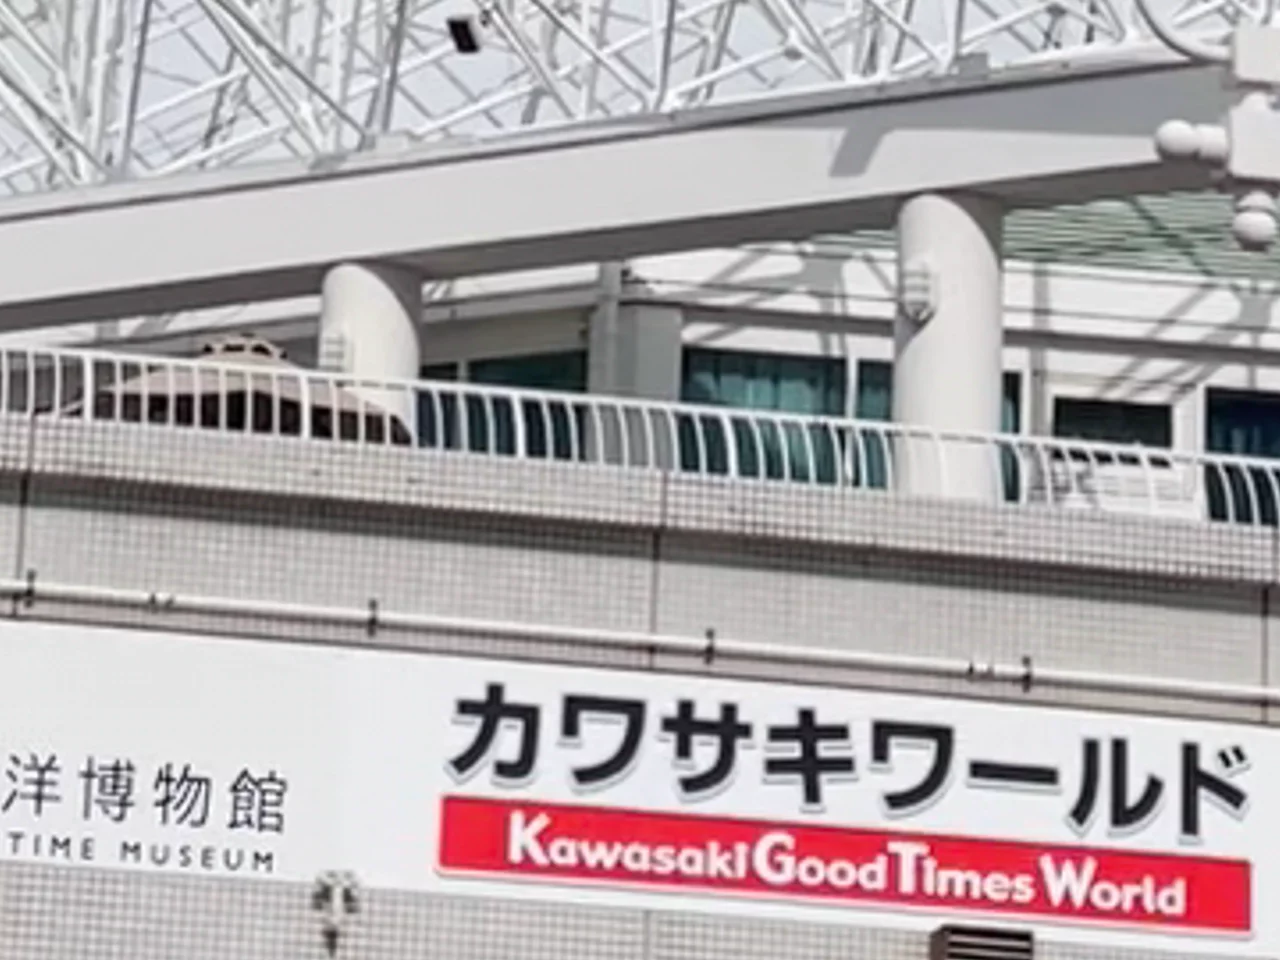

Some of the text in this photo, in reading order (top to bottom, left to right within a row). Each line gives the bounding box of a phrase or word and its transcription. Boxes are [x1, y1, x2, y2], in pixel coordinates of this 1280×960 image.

[451, 683, 1245, 836] カワサキワールド
[121, 842, 276, 873] MUSEUM
[508, 810, 1186, 915] Kawasaki Good Times World
